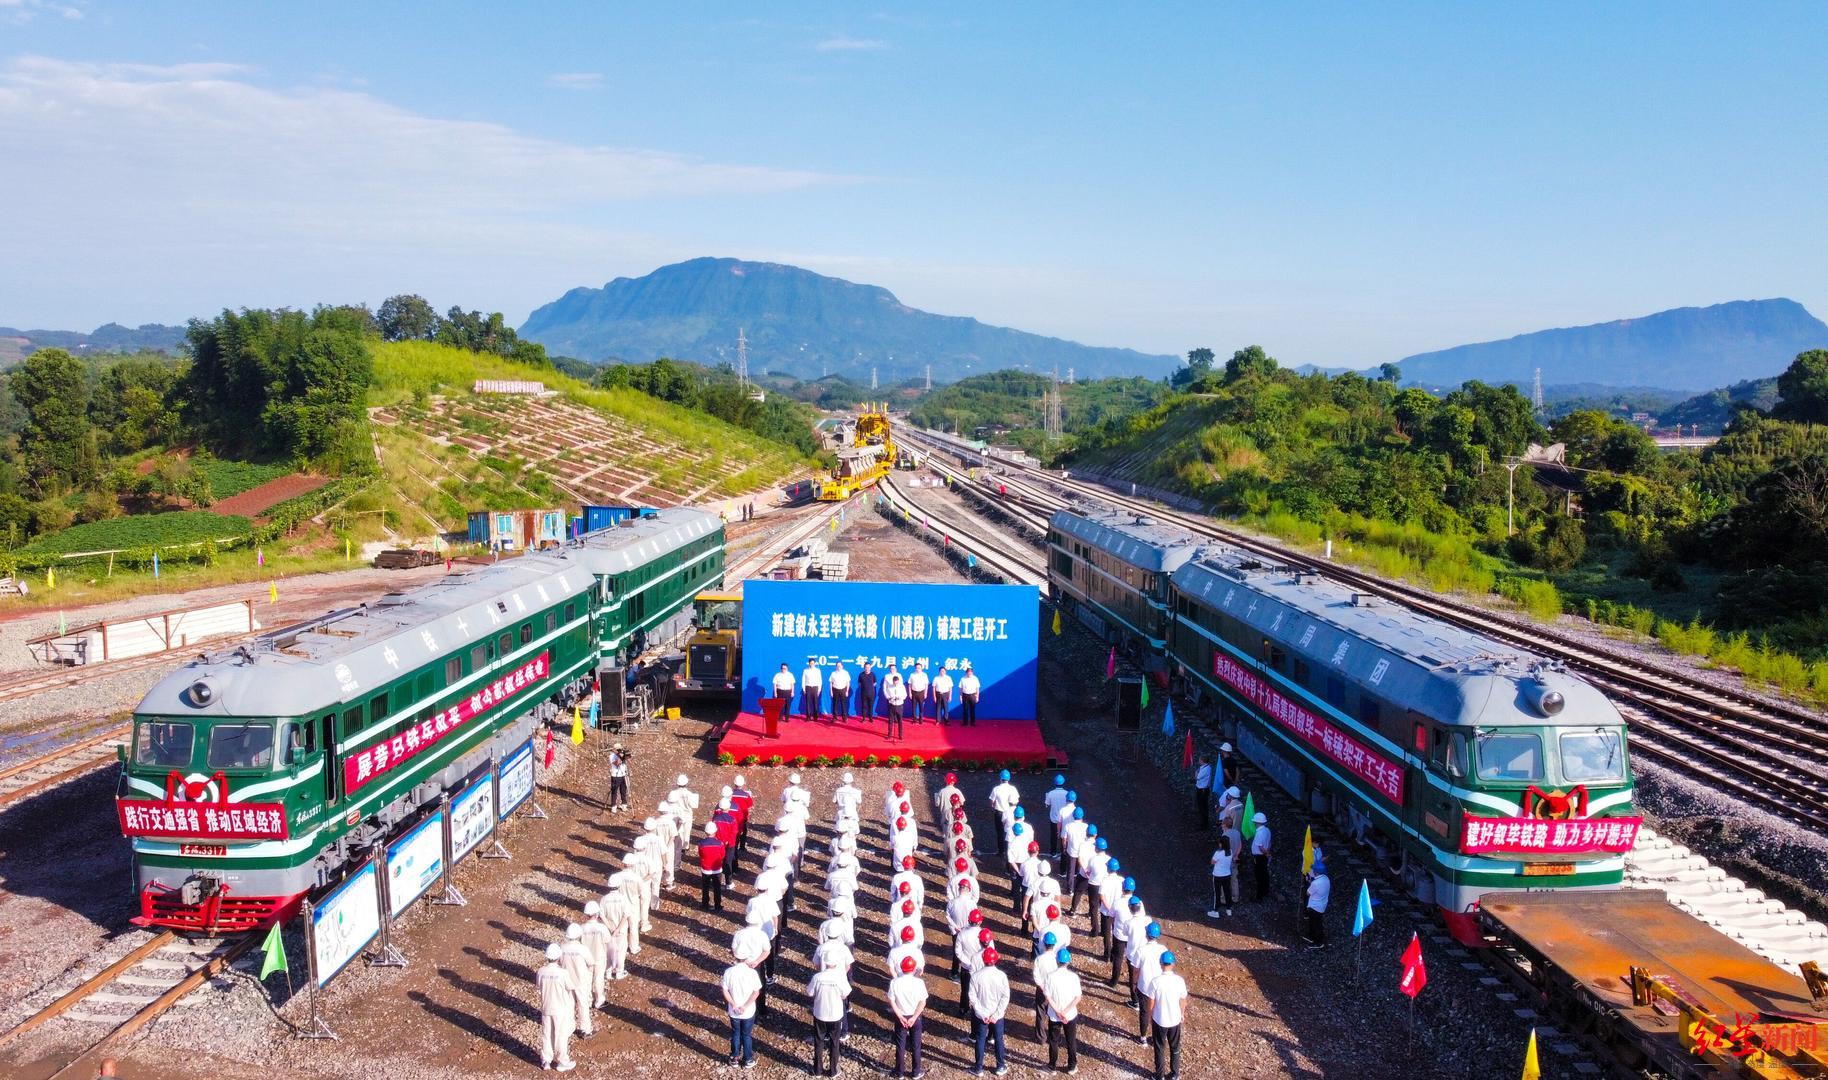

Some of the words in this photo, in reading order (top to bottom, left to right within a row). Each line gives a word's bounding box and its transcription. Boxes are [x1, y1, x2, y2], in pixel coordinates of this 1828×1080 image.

[124, 805, 201, 833] 践行交通强省
[205, 810, 282, 834] 推动区域经济
[1466, 822, 1549, 848] 建好叙毕铁路
[1553, 822, 1635, 848] 助力乡村振兴
